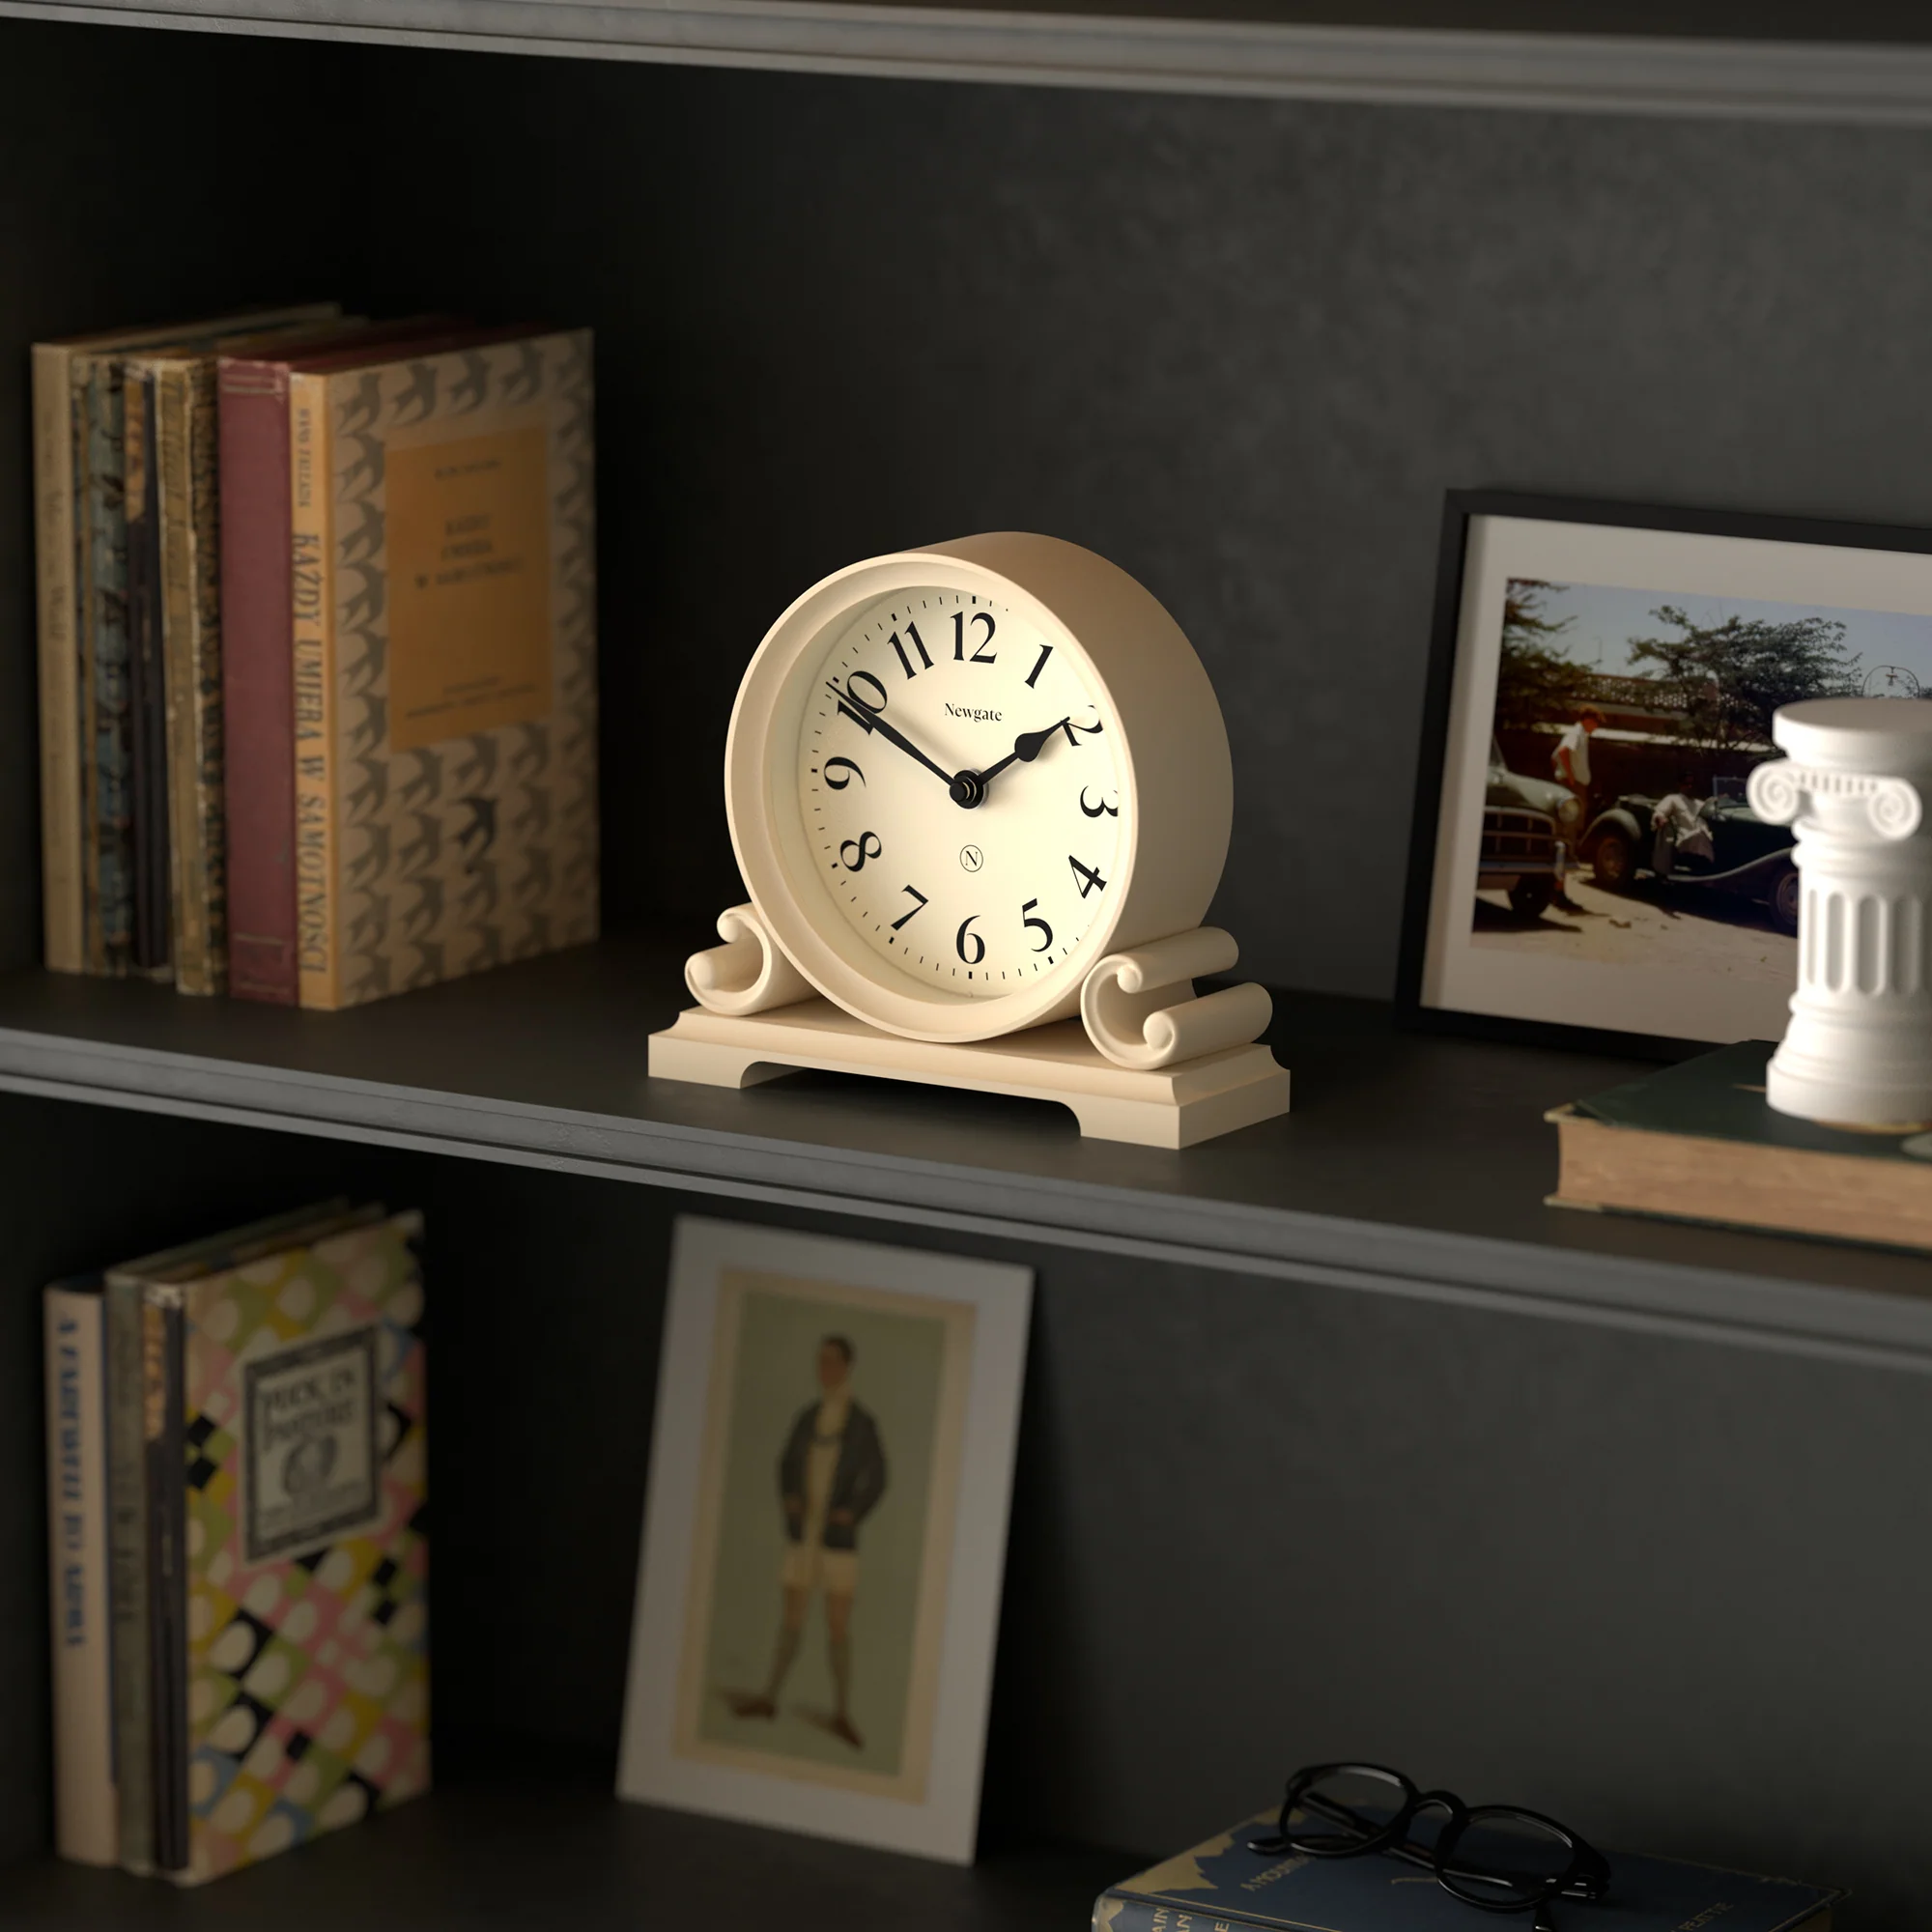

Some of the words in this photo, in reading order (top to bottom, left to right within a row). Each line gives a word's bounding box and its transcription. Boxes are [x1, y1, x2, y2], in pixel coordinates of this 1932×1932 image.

[887, 620, 934, 679] 11
[950, 611, 997, 664] 12
[1024, 644, 1053, 689] 1
[837, 670, 888, 735] 10
[944, 702, 1003, 723] Newgate
[1062, 704, 1103, 747] 2
[298, 754, 326, 781] W
[823, 756, 866, 790] 9
[1079, 784, 1119, 818] 3
[839, 831, 882, 872] 8
[963, 848, 980, 868] N
[1067, 855, 1107, 899] 4
[890, 884, 929, 931] 7
[1021, 897, 1054, 952] 5
[955, 915, 985, 964] 6
